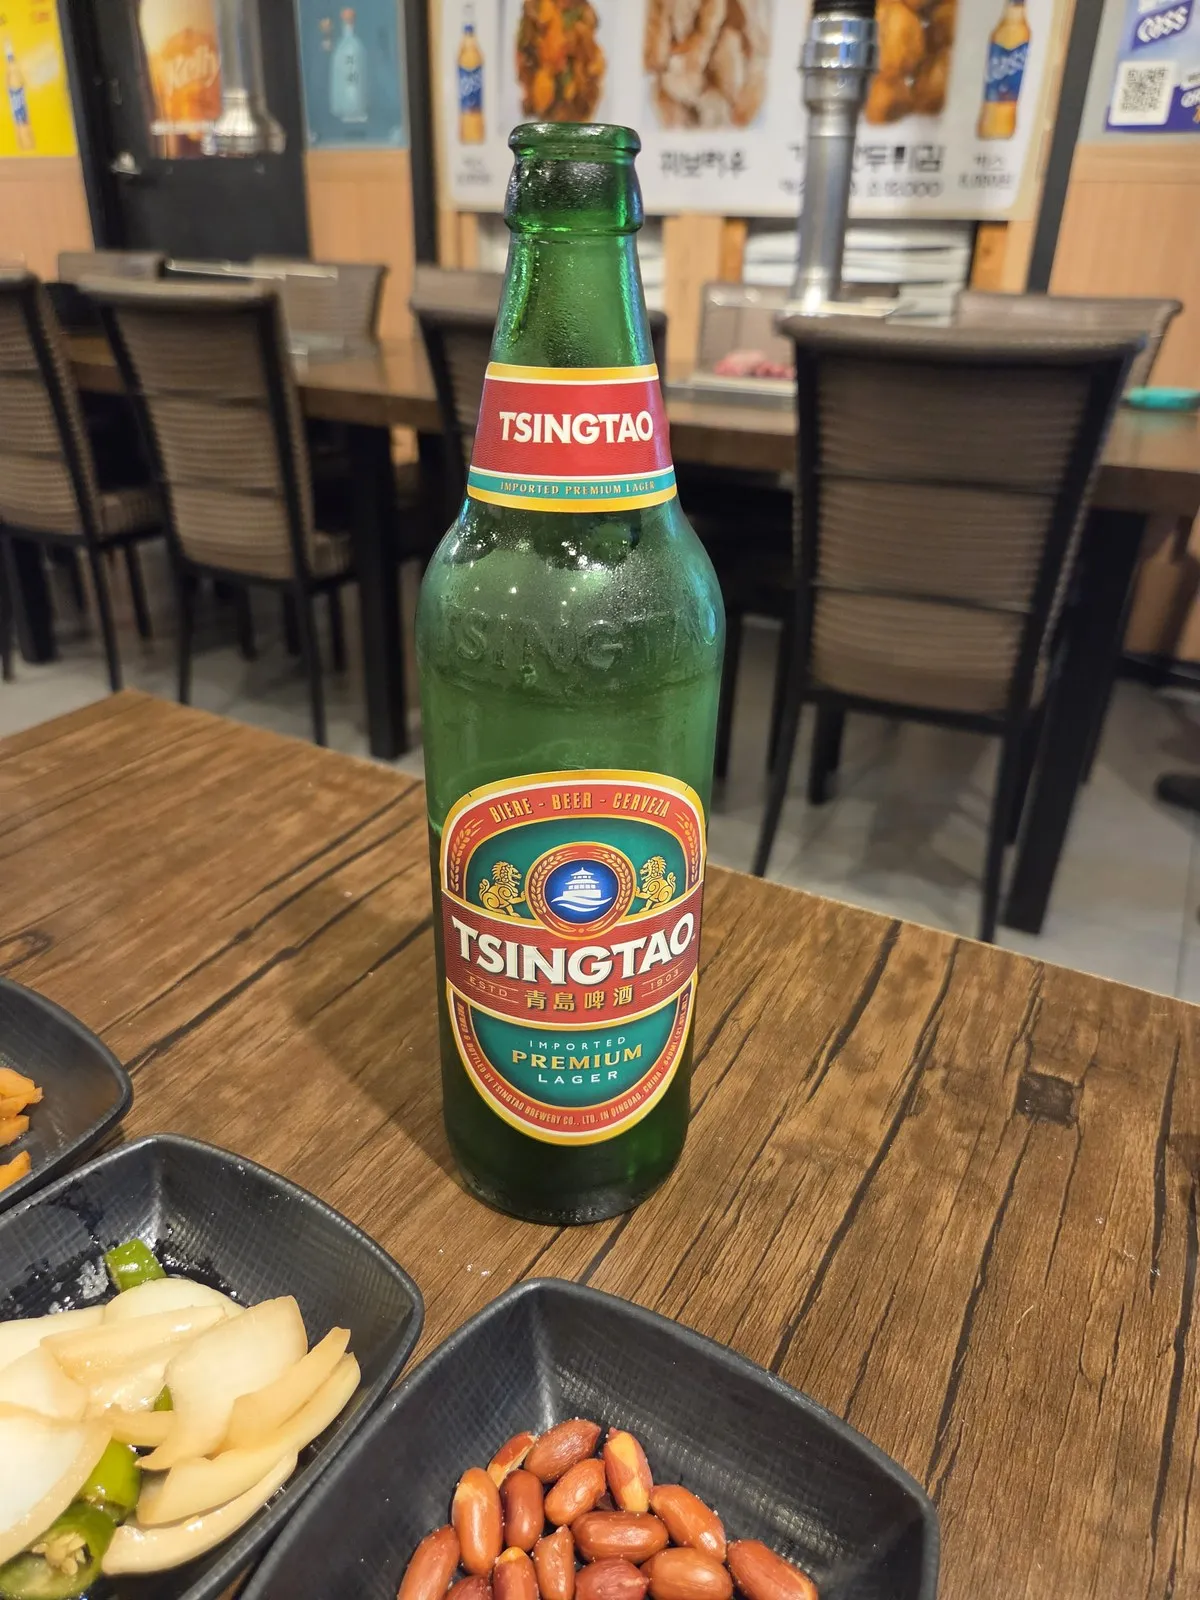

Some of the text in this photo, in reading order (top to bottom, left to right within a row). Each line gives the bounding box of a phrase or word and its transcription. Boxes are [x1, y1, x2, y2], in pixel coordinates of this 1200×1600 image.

[499, 410, 654, 445] TSINGTAO
[500, 480, 656, 496] IMPORTED PREMIUM LAGER
[488, 791, 672, 824] BIERE BEER CERVEZA
[452, 912, 695, 985] TSINGTAO
[469, 975, 508, 998] ESTD
[650, 968, 679, 990] 1903
[525, 984, 633, 1012] 青島啤酒
[511, 1043, 643, 1071] PREMIUM
[529, 1036, 626, 1051] IMPORTED
[465, 1041, 488, 1074] BOTTLED
[483, 1073, 495, 1085] BY
[492, 1081, 526, 1111] TSINGTAO
[524, 1105, 562, 1125] BREWERY
[642, 1070, 663, 1093] CHINA
[537, 1070, 619, 1085] LAGER
